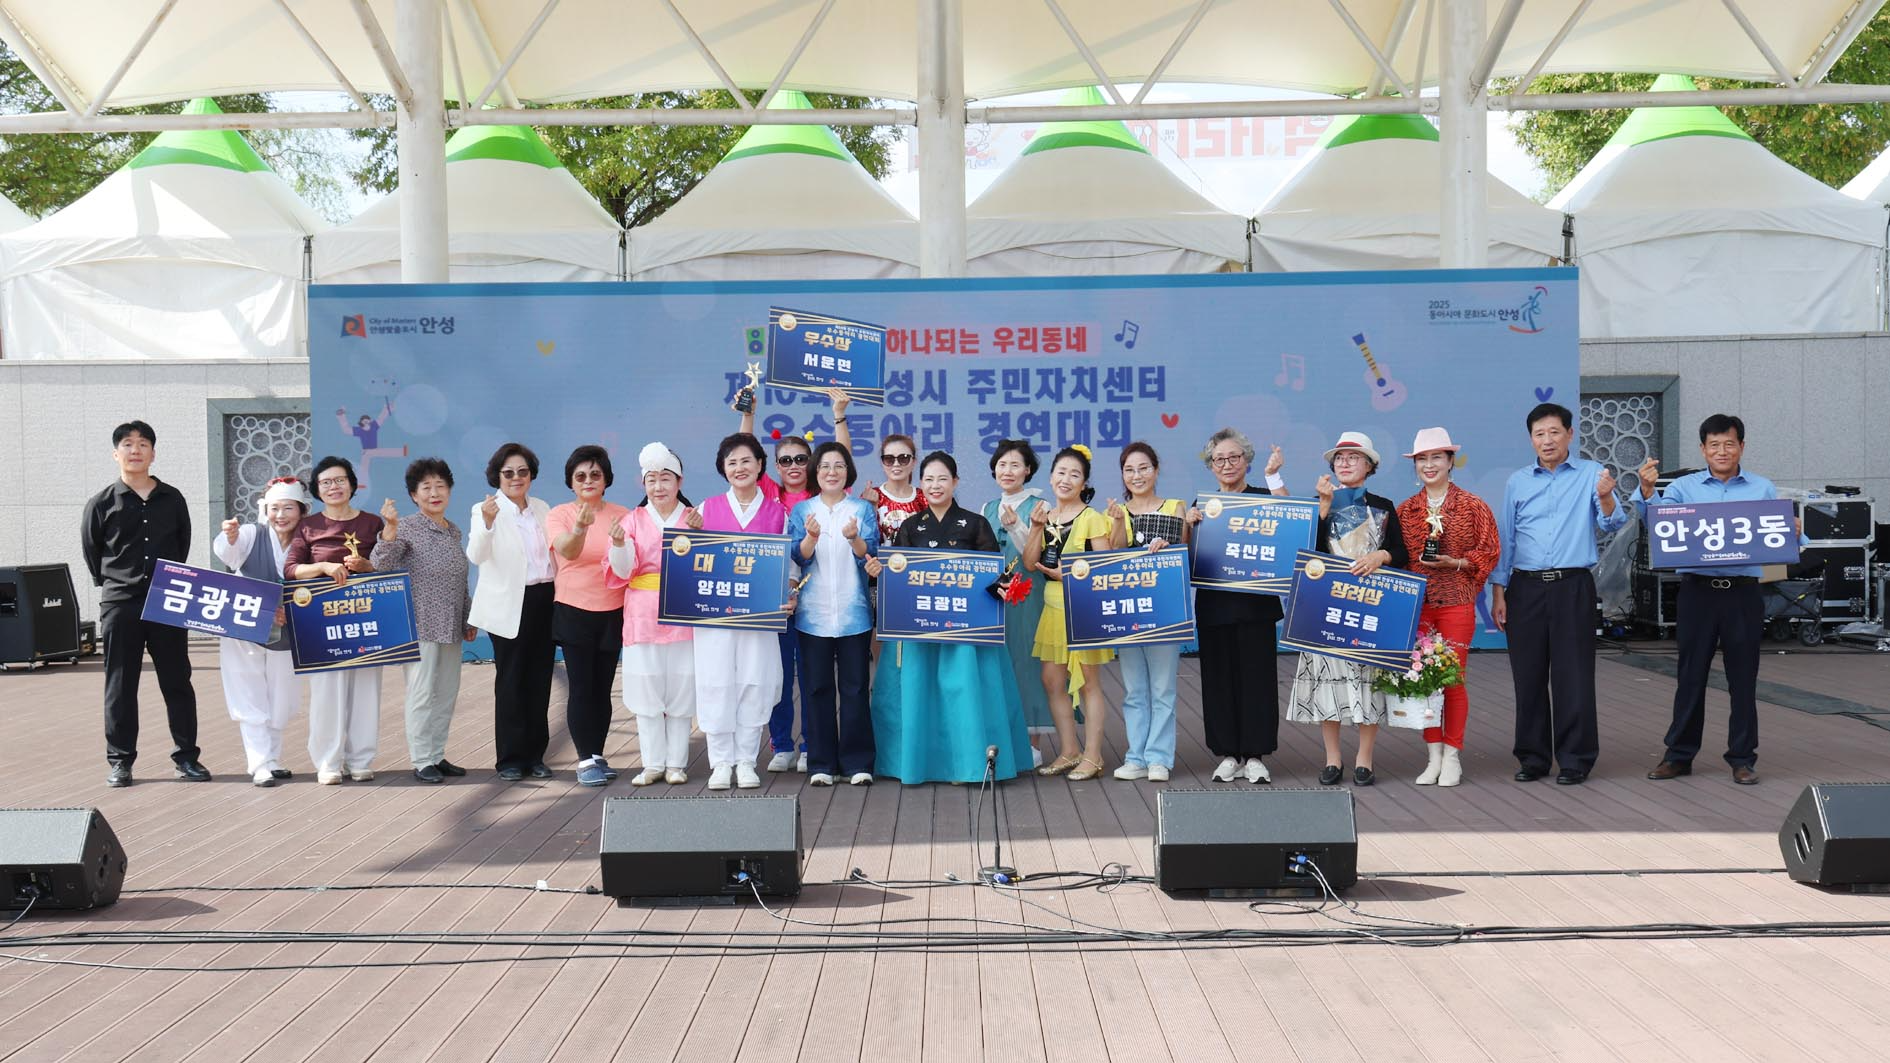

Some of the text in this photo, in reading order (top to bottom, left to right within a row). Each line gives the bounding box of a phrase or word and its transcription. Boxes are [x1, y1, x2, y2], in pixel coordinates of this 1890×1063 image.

[1429, 300, 1450, 309] 2025
[1498, 309, 1520, 321] 안성
[419, 316, 455, 335] 안성
[804, 331, 853, 352] 우수상
[885, 328, 981, 355] 하나되는
[993, 326, 1087, 353] 우리동네
[803, 353, 852, 373] 서운면
[884, 366, 1167, 407] 성시 주민자치센터
[977, 409, 1132, 455] 경연대회
[1228, 516, 1280, 536] 우수상
[1654, 514, 1791, 553] 안성3동
[1225, 542, 1276, 562] 죽산면
[698, 580, 750, 597] 양성면
[907, 570, 976, 589] 최우수상
[1091, 571, 1160, 591] 최우수상
[163, 578, 263, 627] 금광면
[1330, 580, 1385, 606] 장려상
[322, 597, 375, 617] 장려상
[916, 595, 968, 612] 금광면
[1101, 597, 1153, 615] 보개면
[1325, 606, 1379, 632] 공도읍
[326, 621, 379, 640] 미양면
